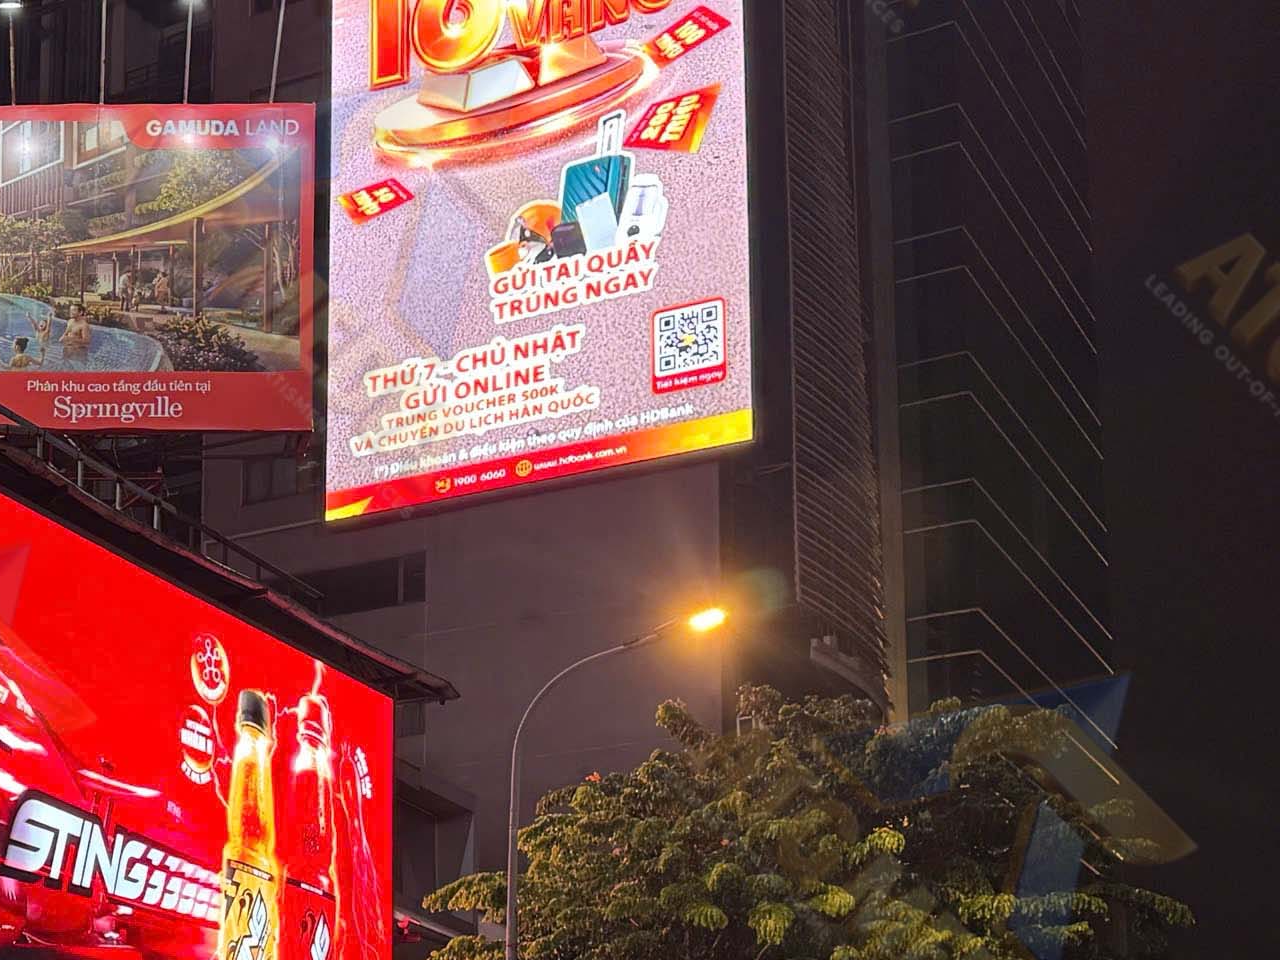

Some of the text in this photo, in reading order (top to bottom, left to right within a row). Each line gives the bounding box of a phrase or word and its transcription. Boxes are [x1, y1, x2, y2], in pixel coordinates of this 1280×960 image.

[146, 119, 299, 138] GAMUDA LAND
[493, 267, 537, 295] GỬI
[585, 268, 654, 300] NGAY
[424, 363, 437, 381] 7
[456, 341, 506, 373] CHỦ
[513, 330, 581, 358] NHẬT
[26, 380, 212, 394] Phân khu cao tầng đầu tiên tại
[404, 364, 546, 410] GỬI ONLINE
[442, 383, 559, 418] VOUCHER 500K
[53, 395, 183, 423] Springville
[526, 430, 556, 444] theo
[557, 425, 582, 441] quy
[639, 403, 695, 425] HDBank
[443, 419, 465, 434] DU
[453, 474, 478, 488] 1900
[480, 469, 507, 482] 6060
[5, 798, 148, 900] STING
